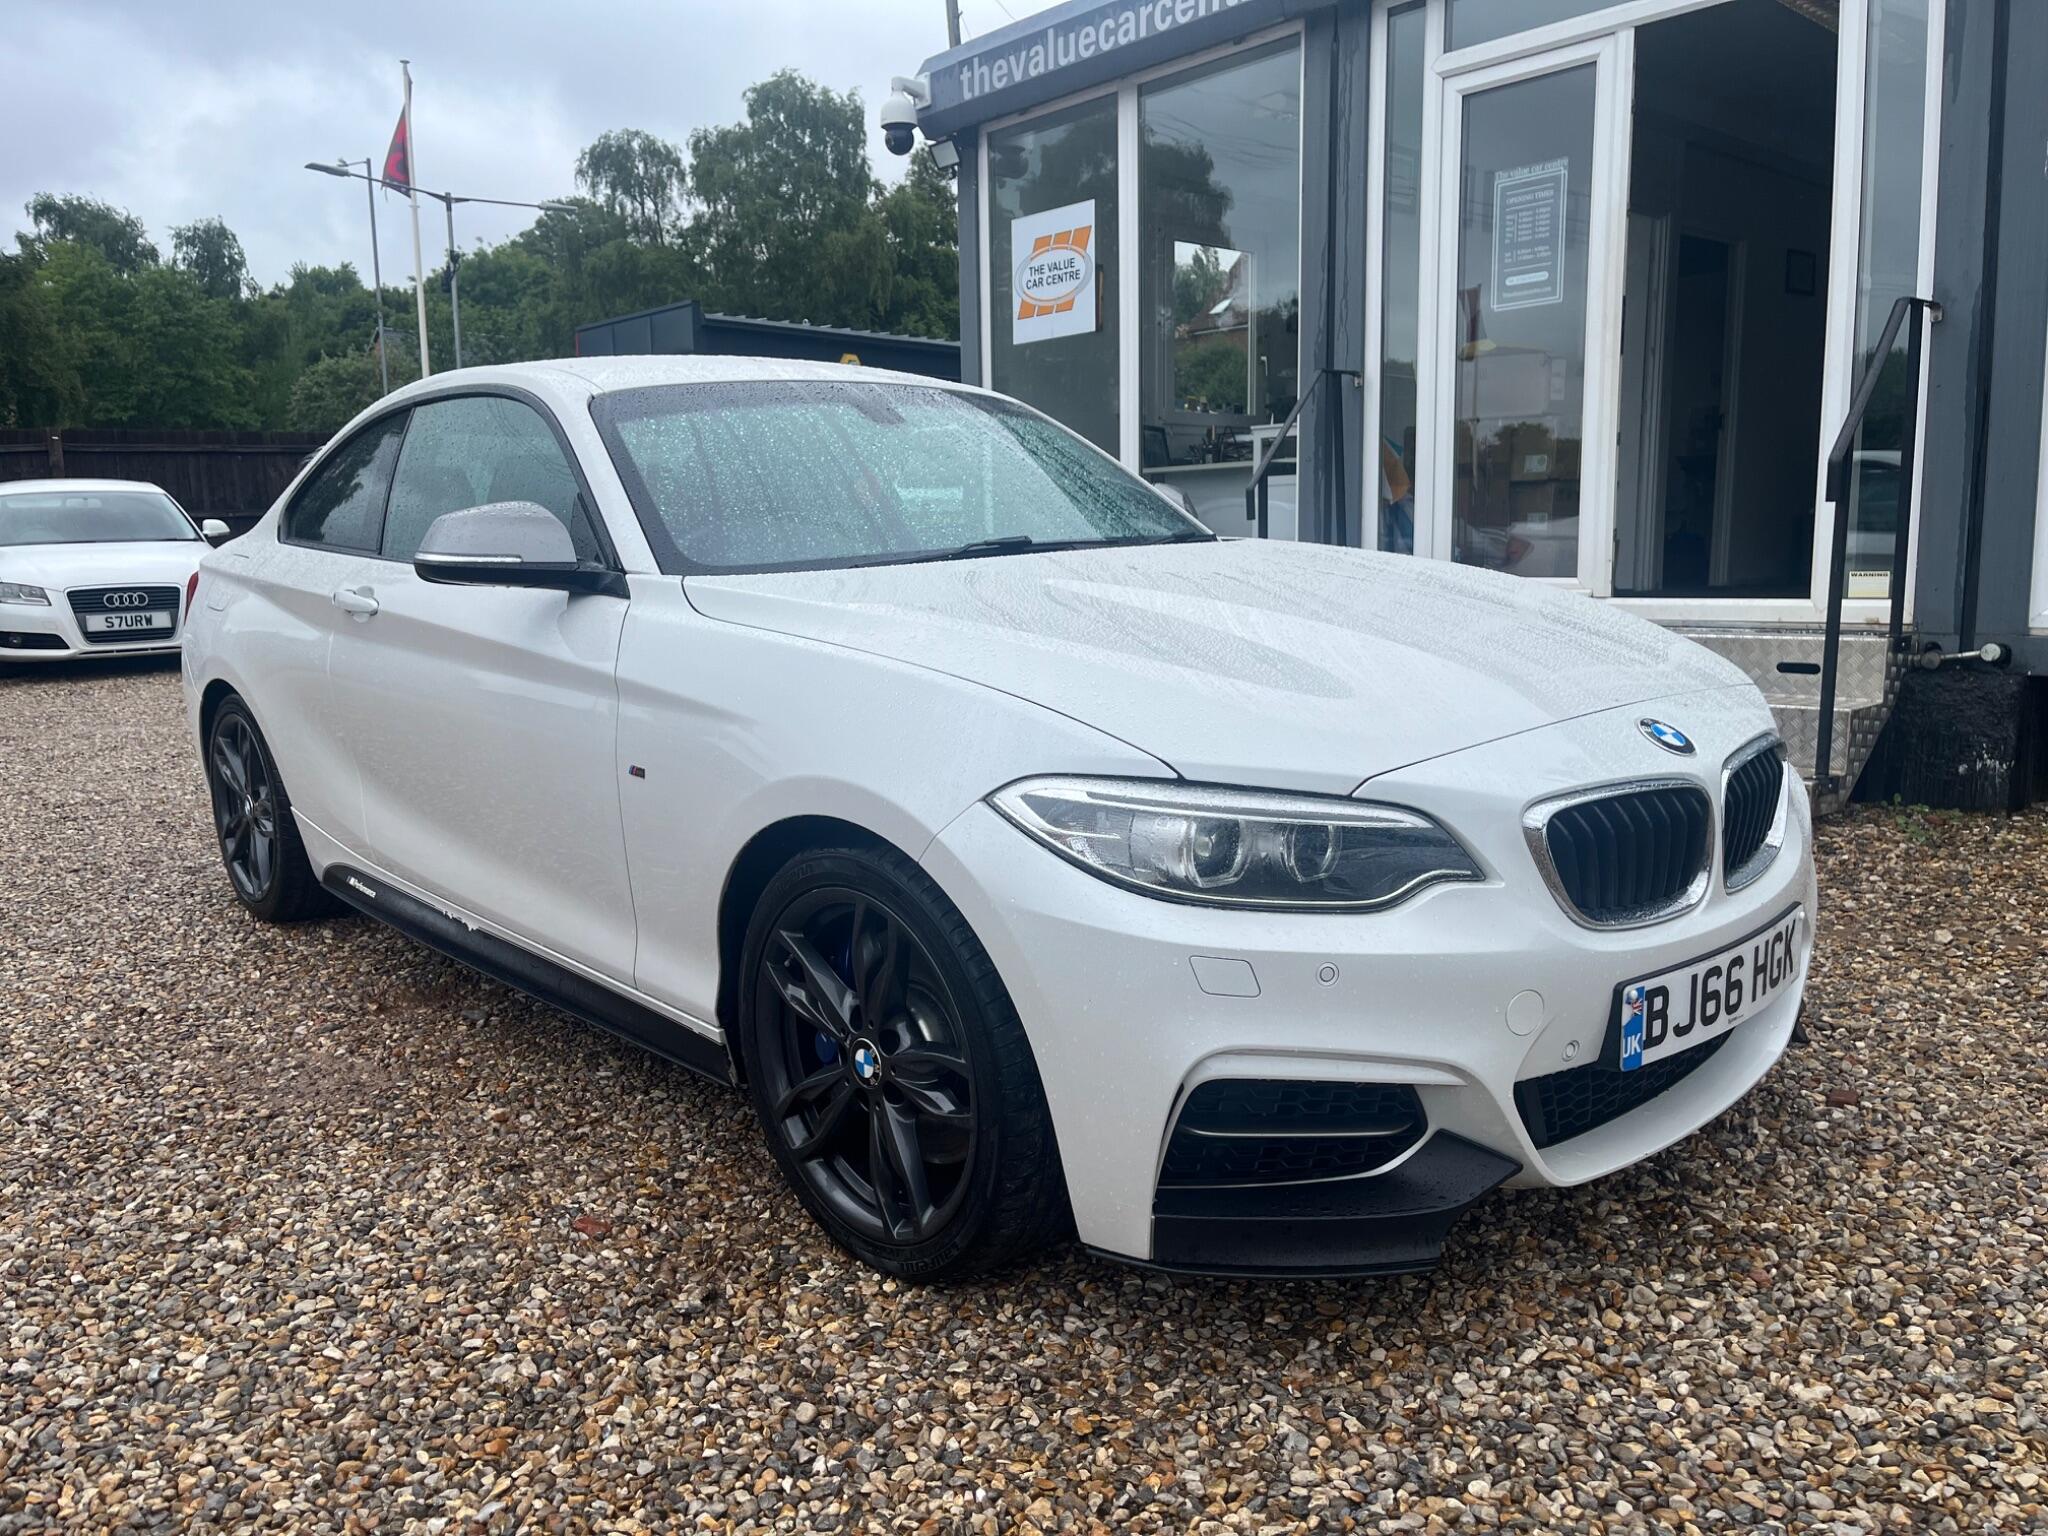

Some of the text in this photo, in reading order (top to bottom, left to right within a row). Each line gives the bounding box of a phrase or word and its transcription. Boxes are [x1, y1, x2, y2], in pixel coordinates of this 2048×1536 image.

[1029, 257, 1076, 277] THE VALUE
[1026, 269, 1081, 290] CAR CENTRE
[1643, 918, 1796, 1050] BJ66 HGK
[1622, 1032, 1641, 1058] UK
